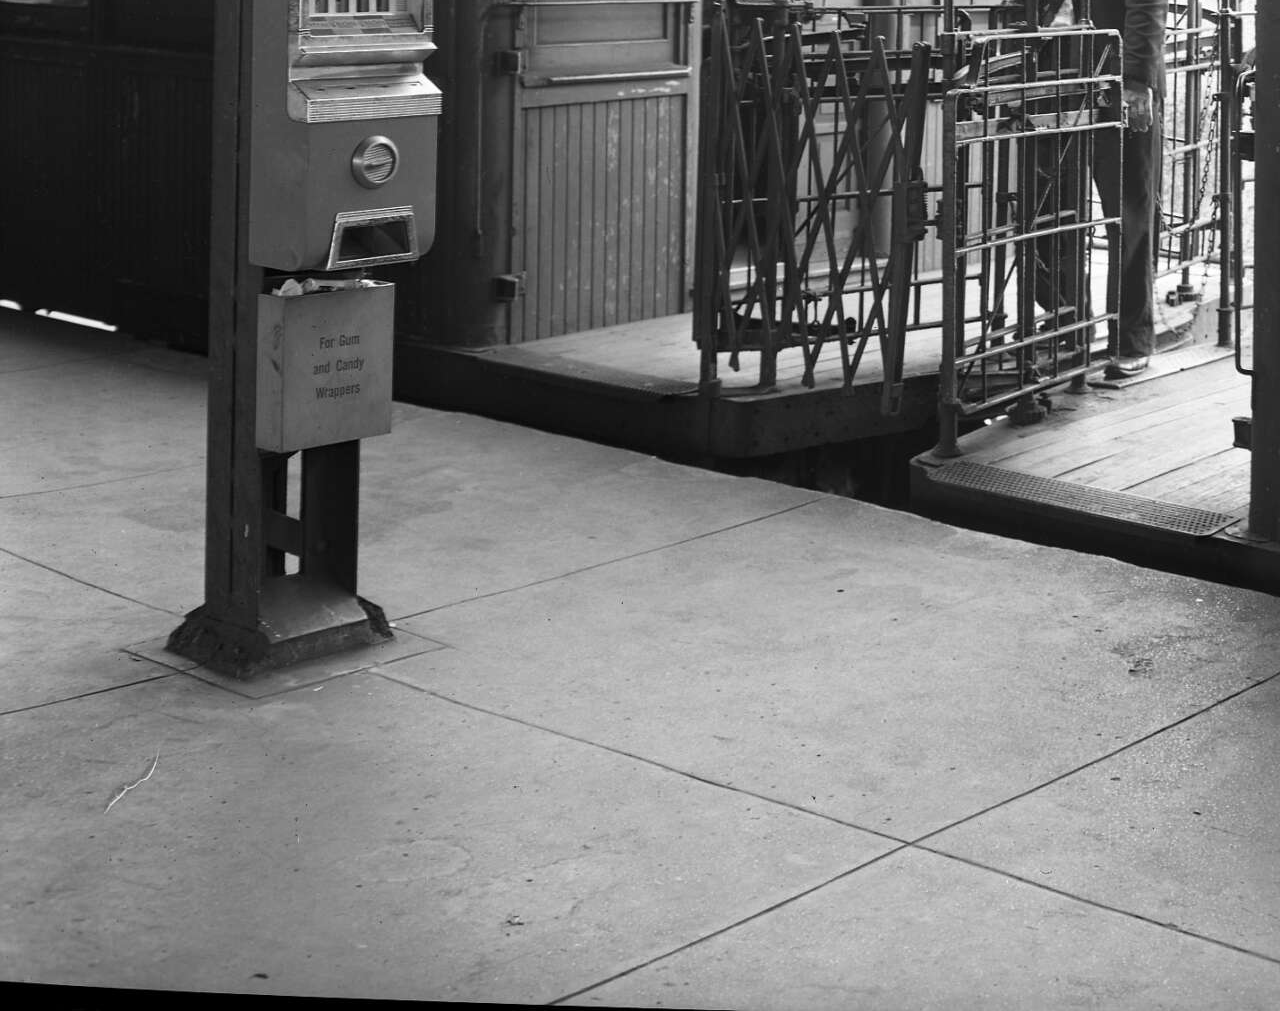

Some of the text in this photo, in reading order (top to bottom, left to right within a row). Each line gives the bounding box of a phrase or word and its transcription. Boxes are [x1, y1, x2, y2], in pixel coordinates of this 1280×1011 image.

[319, 334, 360, 349] For Gum
[313, 357, 364, 375] and Candy
[315, 383, 361, 400] Wrappers
